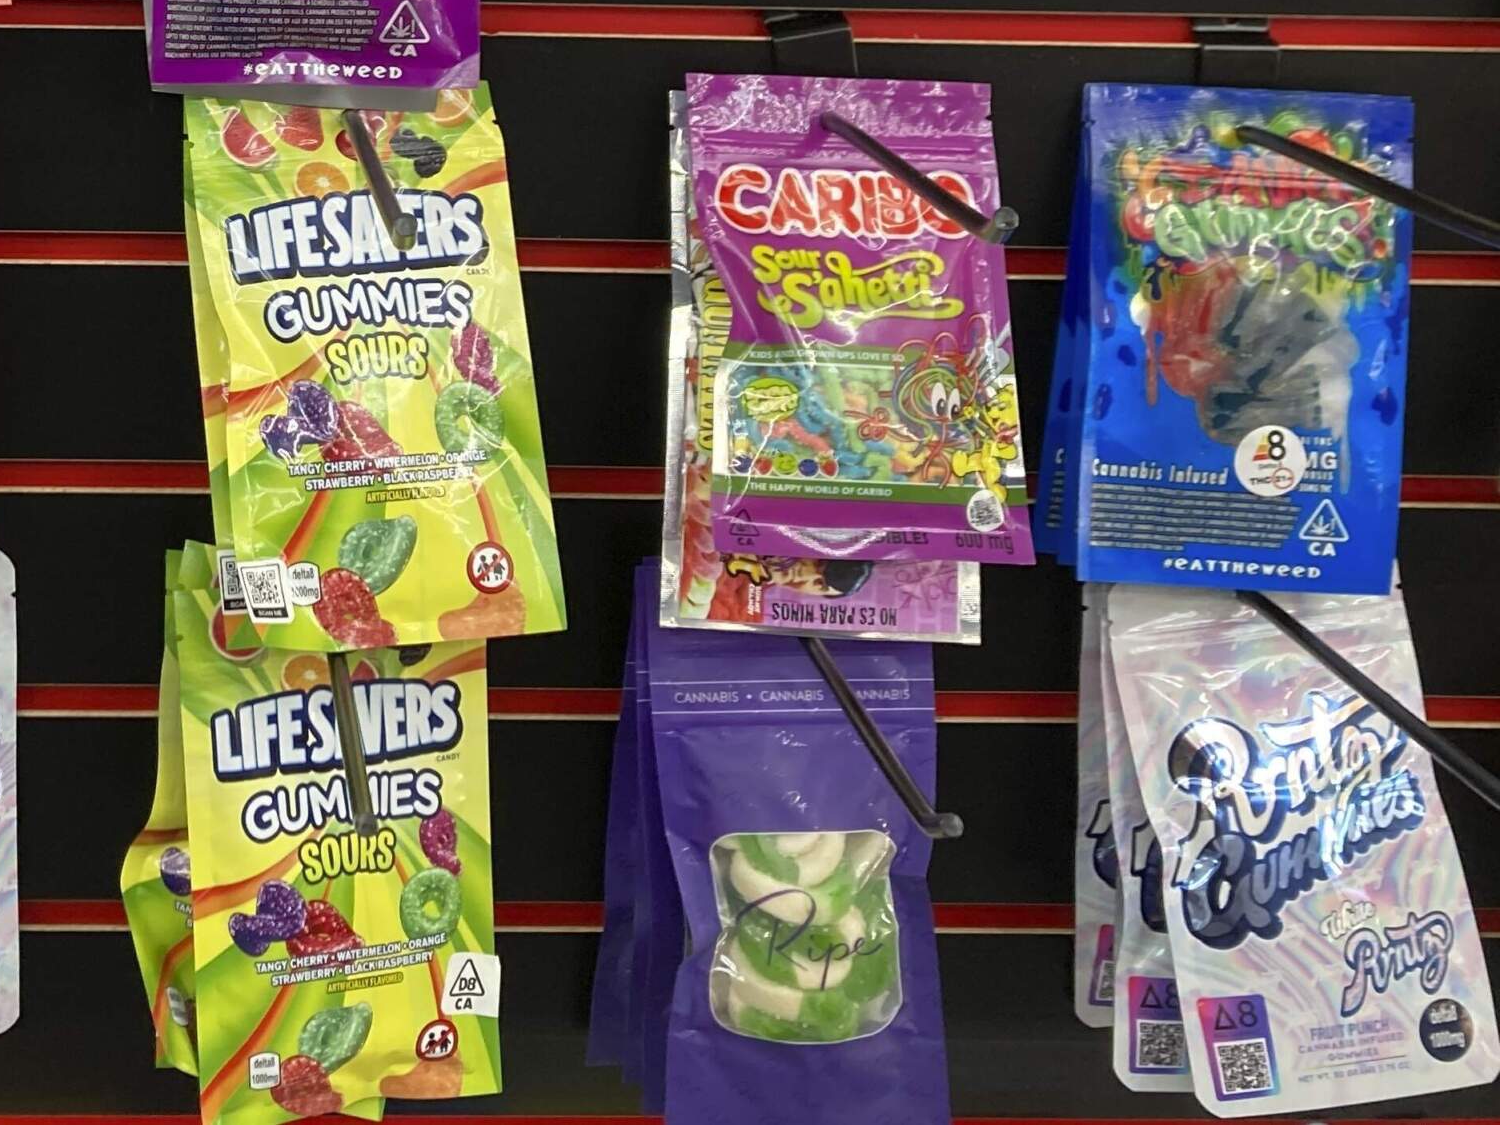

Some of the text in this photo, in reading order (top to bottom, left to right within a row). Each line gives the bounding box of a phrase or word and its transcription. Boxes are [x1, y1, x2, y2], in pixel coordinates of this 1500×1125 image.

[389, 45, 418, 57] CA
[715, 168, 974, 237] CARIBO
[752, 244, 821, 284] Sour
[266, 281, 472, 340] GUMMIES
[327, 333, 427, 380] SOURS
[857, 352, 881, 361] LOVE
[288, 462, 322, 476] TANGY
[324, 459, 366, 473] CHERRY
[374, 453, 439, 469] WATERMELON
[1092, 458, 1229, 486] Cannabis Infused
[305, 471, 416, 491] STRAWBERRY BLACK
[750, 482, 893, 496] THE HAPPY WORLD OF CARIBO
[1250, 477, 1272, 486] THC
[366, 489, 411, 503] ARTIFICIALLY
[1308, 542, 1336, 557] CA
[819, 603, 855, 623] PARA
[860, 606, 876, 624] ES
[674, 690, 824, 704] CANNABIS CANNABIS
[214, 682, 458, 774] LIFE SVERS
[436, 752, 461, 762] CANDY
[300, 830, 396, 884] SOURS
[737, 888, 884, 991] Ripe
[255, 933, 447, 974] TANGY CHERRY WATERMELON ORANGE
[271, 950, 434, 987] STRAWBERRY BLACK RASPBERRY
[327, 977, 369, 994] ARTIFICIALLY
[458, 977, 477, 992] D8
[455, 997, 473, 1010] CA
[1309, 1020, 1390, 1041] FRUIT PUNCH
